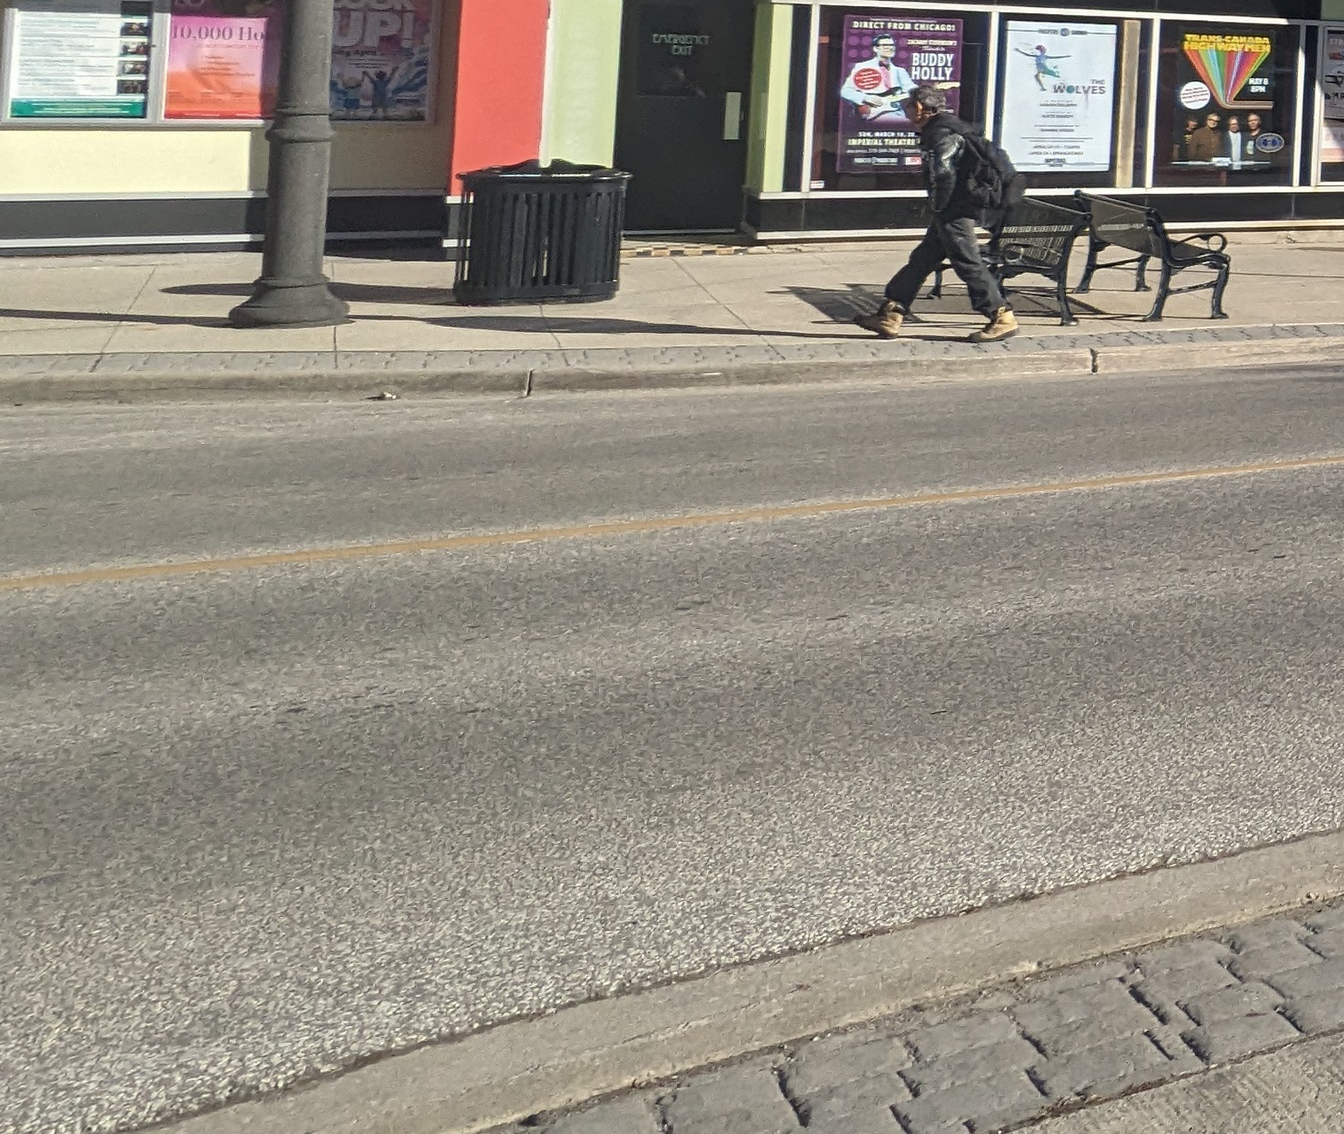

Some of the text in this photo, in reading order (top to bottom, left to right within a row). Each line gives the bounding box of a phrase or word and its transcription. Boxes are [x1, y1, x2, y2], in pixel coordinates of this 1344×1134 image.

[333, 10, 415, 48] UP!
[852, 20, 885, 29] DIRECT
[887, 22, 911, 31] FROM
[172, 25, 233, 41] 10,000
[1184, 34, 1270, 44] TRANS-CANADA
[672, 45, 693, 55] EXIT
[1184, 41, 1271, 53] HIGHWAYMEN
[912, 52, 955, 67] BUDDY
[911, 66, 954, 81] HOLLY
[1053, 85, 1106, 95] WOLVES
[848, 138, 915, 146] IMPERIAL THEATRE
